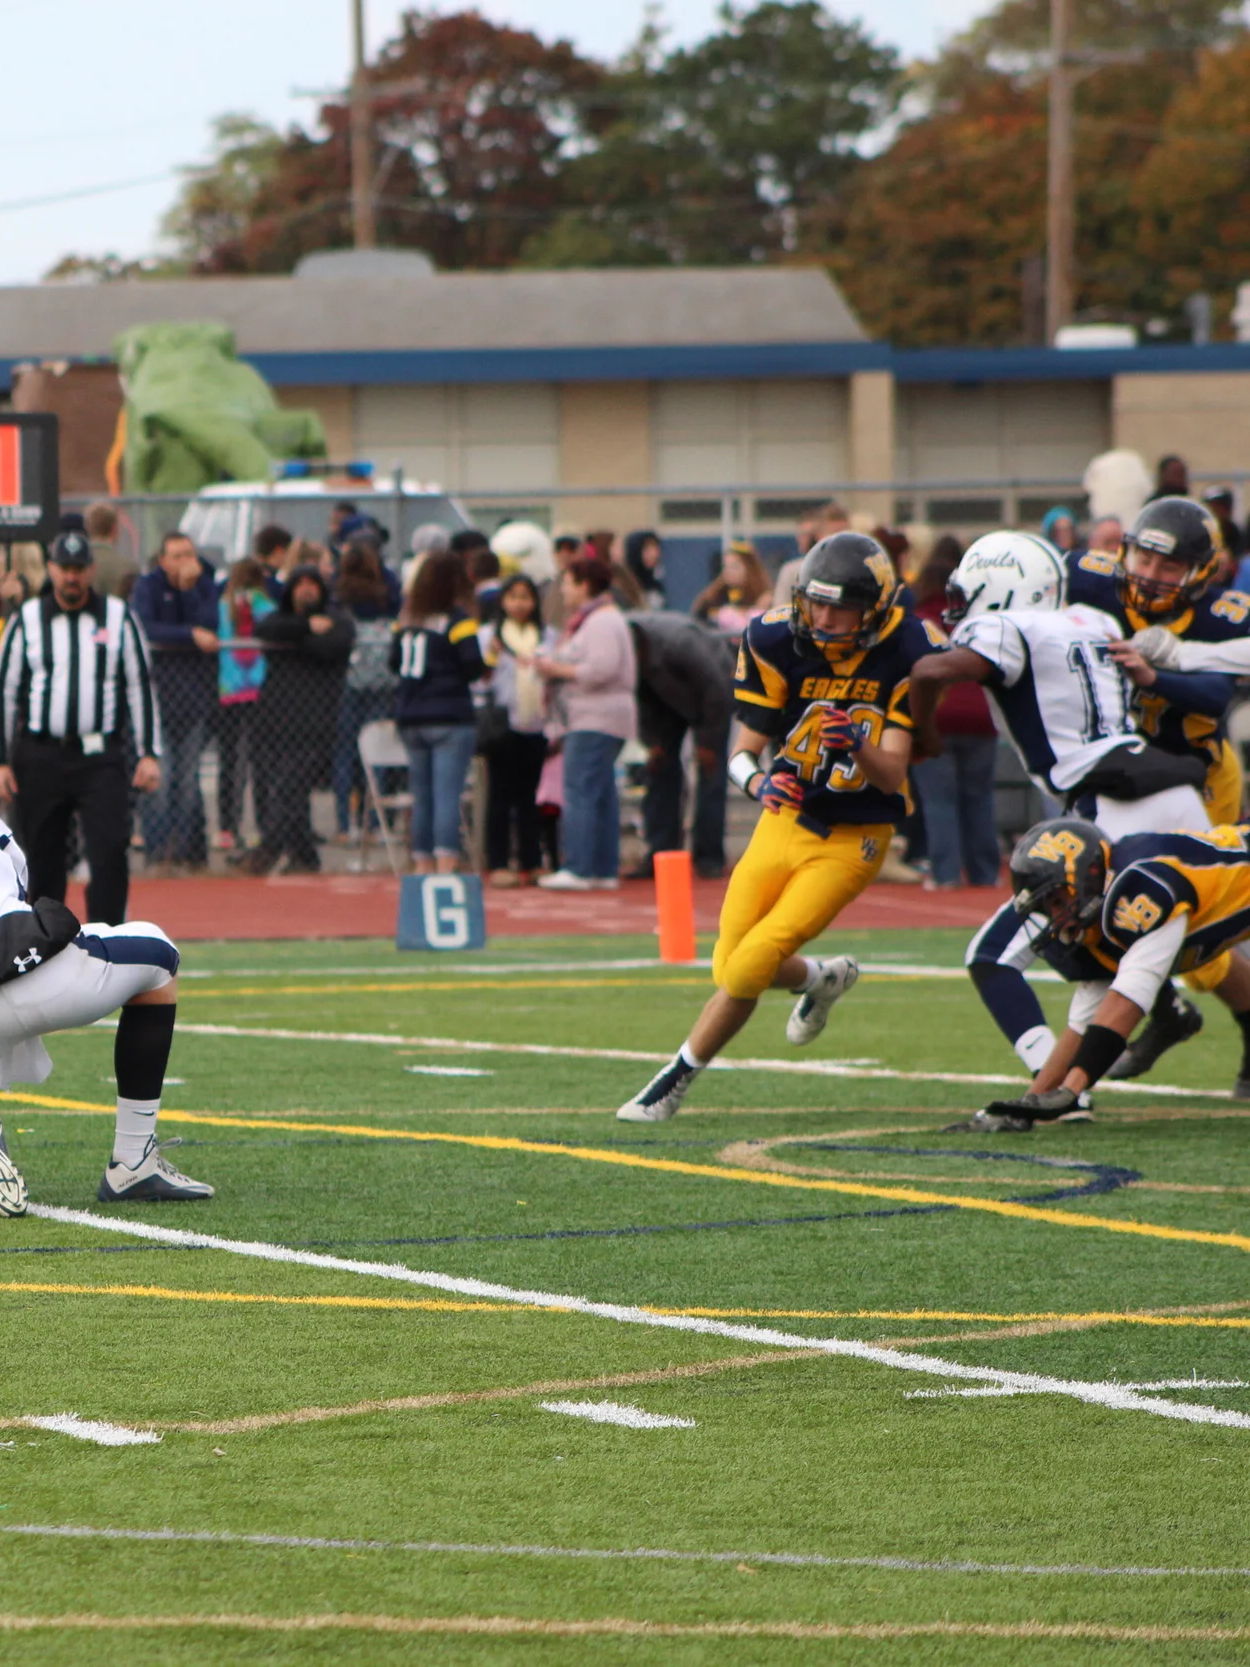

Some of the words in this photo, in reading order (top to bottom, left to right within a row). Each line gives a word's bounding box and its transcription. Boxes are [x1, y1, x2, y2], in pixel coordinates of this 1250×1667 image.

[966, 550, 1016, 573] Devils
[799, 677, 881, 702] EAGLES
[784, 700, 886, 792] 43
[421, 874, 469, 949] G
